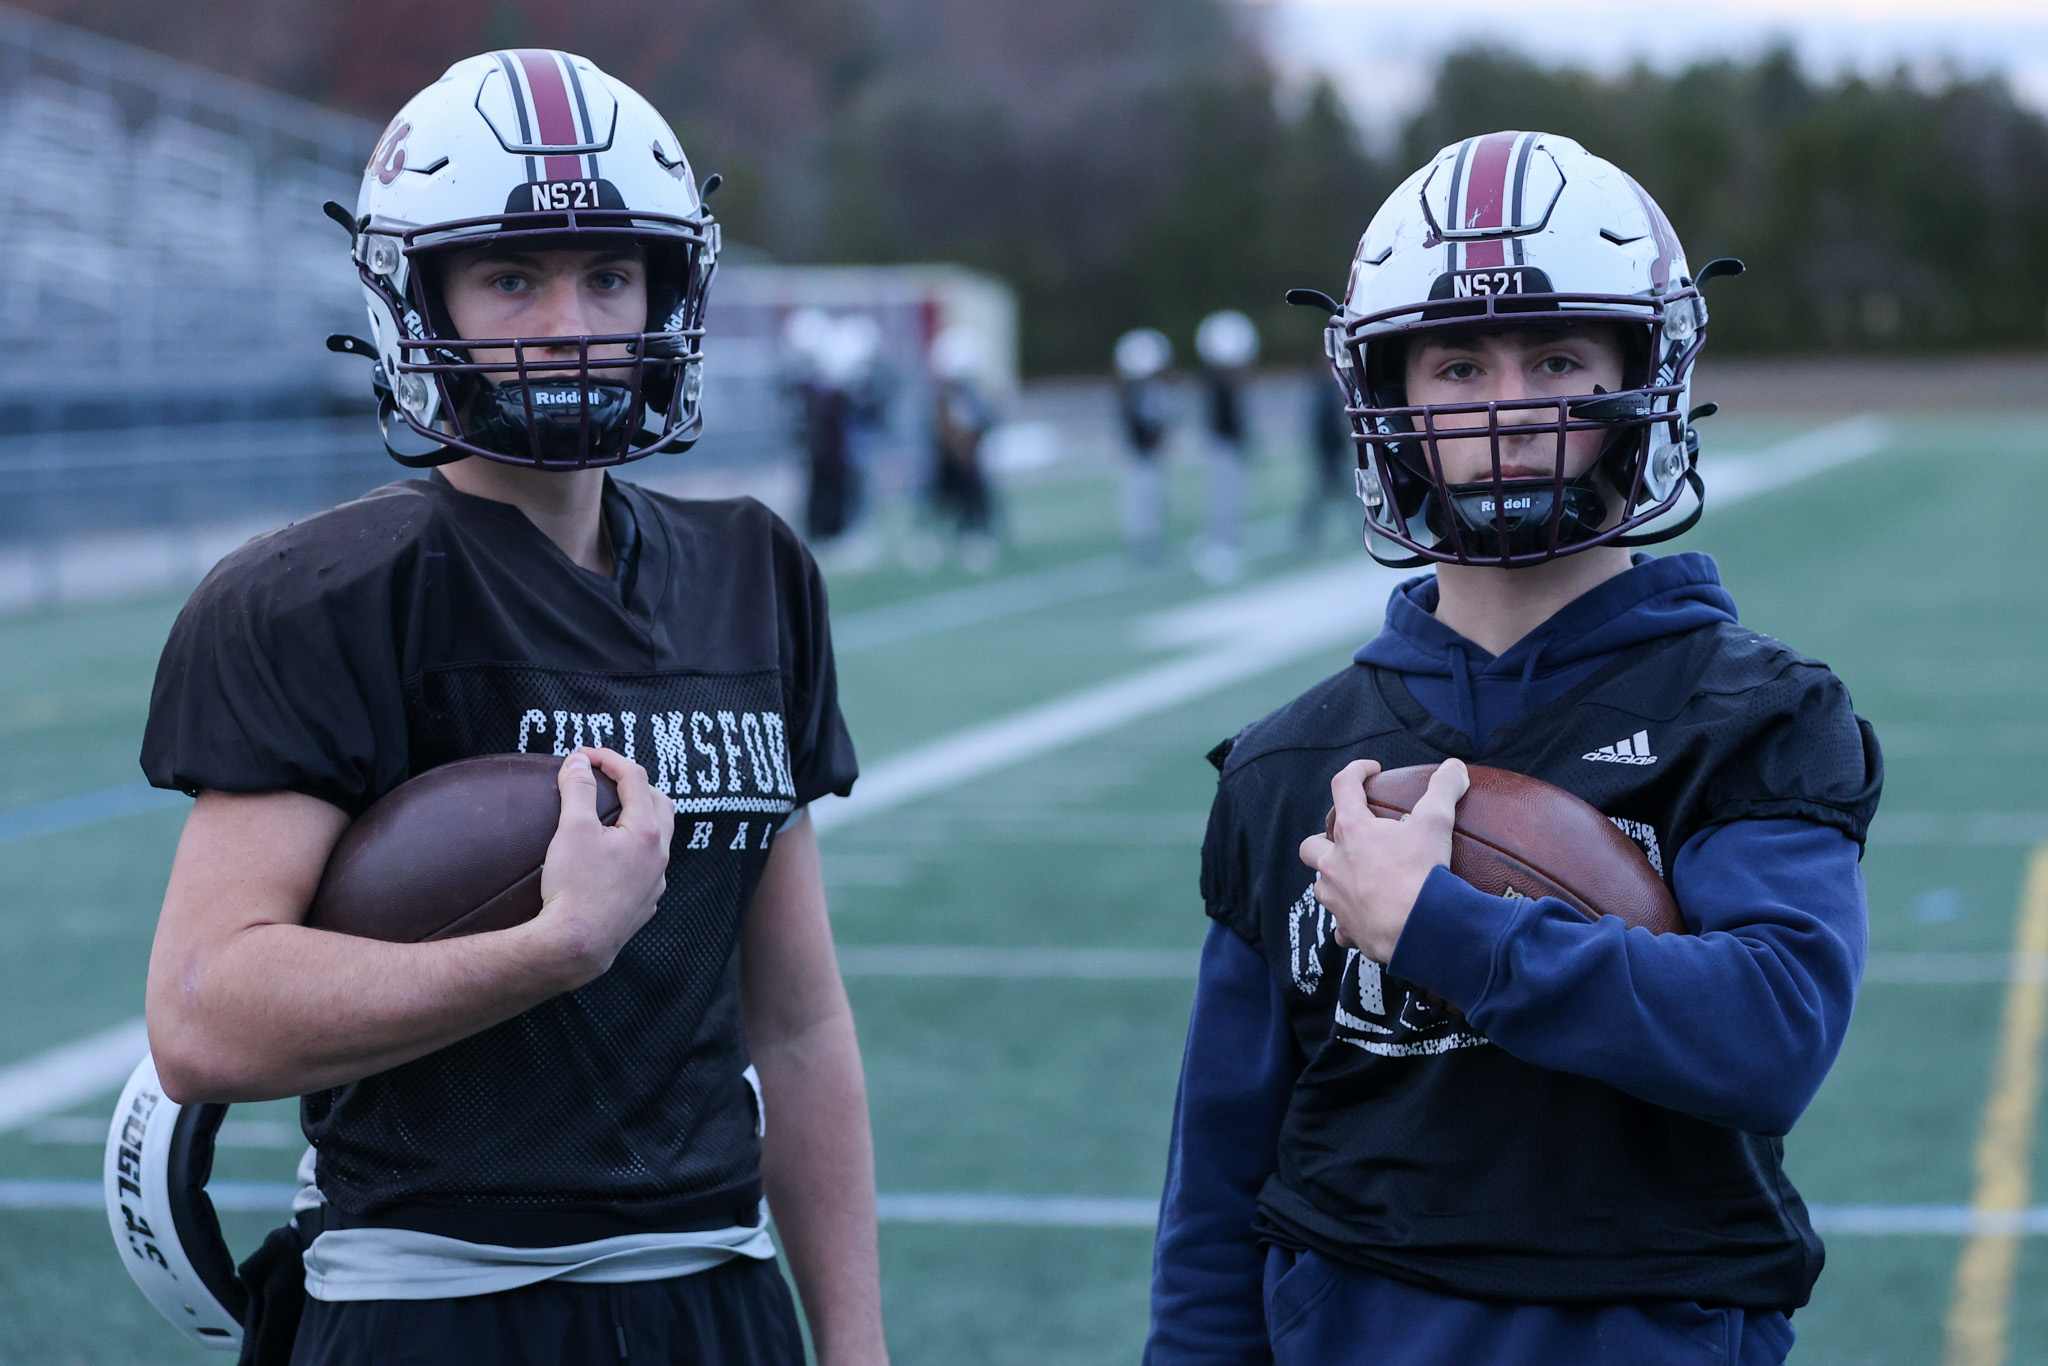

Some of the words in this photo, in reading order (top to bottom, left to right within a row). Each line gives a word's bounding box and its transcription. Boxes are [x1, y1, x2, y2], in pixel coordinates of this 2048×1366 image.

[531, 181, 599, 211] NS21
[1453, 271, 1523, 298] NS21
[535, 391, 599, 405] Riddll
[1481, 497, 1531, 512] Ridell
[1581, 752, 1658, 766] adidas
